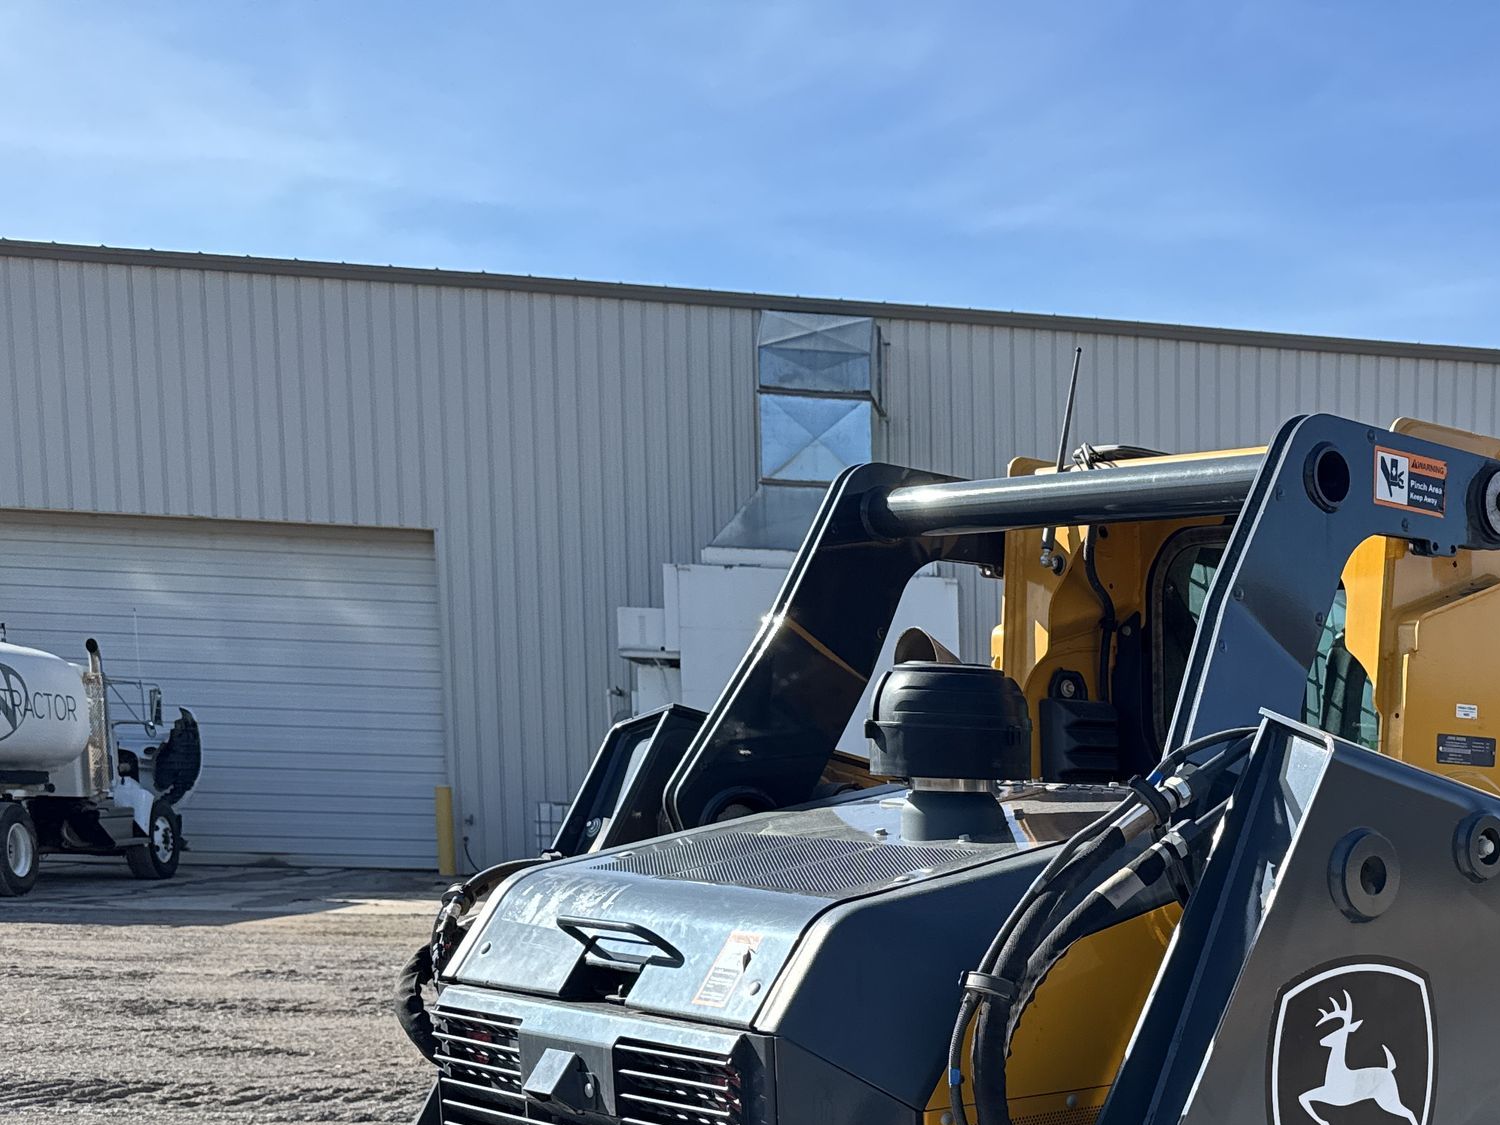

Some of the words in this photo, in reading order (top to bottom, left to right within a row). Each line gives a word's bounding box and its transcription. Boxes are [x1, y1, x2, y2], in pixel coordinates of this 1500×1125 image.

[1416, 462, 1445, 475] WARNING
[1410, 480, 1428, 491] Pinch
[1428, 484, 1443, 495] Area
[1409, 492, 1424, 502] Keep
[1423, 495, 1438, 506] Away
